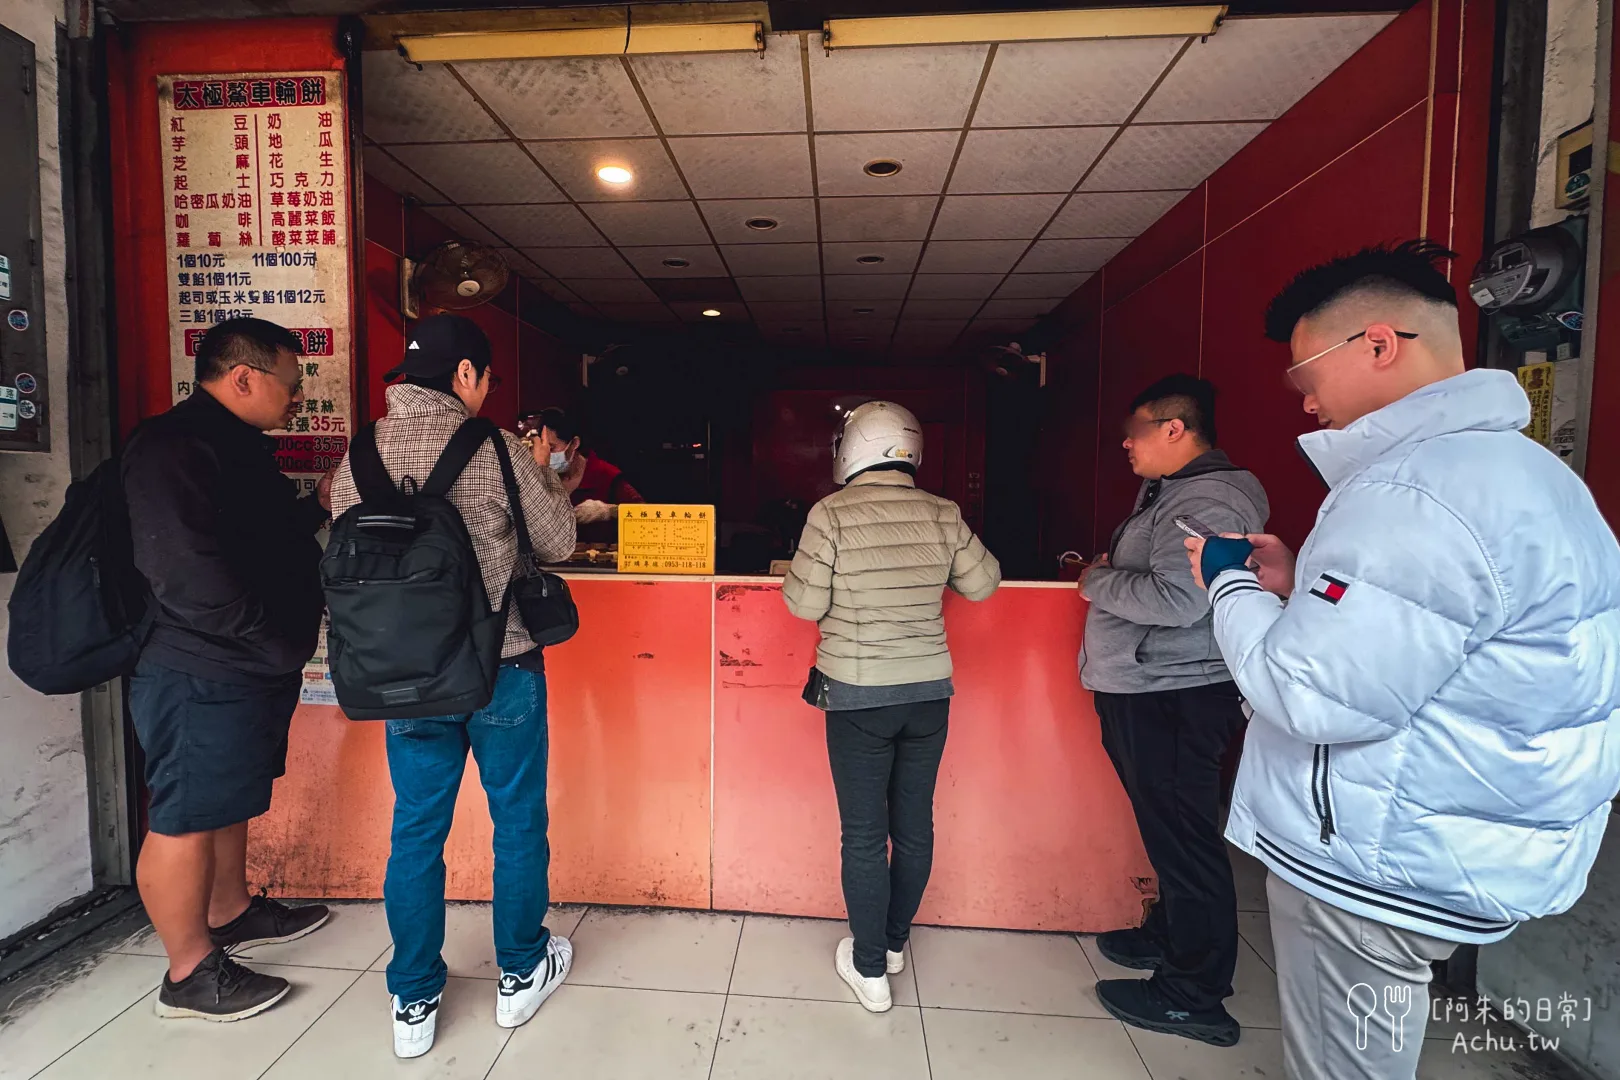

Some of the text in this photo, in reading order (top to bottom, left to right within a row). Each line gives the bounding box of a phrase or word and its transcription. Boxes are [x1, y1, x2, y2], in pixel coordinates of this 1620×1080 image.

[171, 115, 248, 133] 紅豆
[267, 111, 333, 129] 奶油
[172, 134, 249, 152] 芋頭
[268, 131, 333, 149] 地瓜
[173, 154, 250, 172] 芝麻
[269, 151, 334, 169] 花生
[174, 173, 250, 191] 起士
[270, 171, 334, 189] 巧克力
[175, 193, 252, 210] 哈密瓜奶油
[270, 190, 334, 208] 草莓奶油
[176, 211, 252, 229] 咖啡
[271, 209, 336, 227] 高麗菜飯
[177, 253, 226, 268] 1個10元
[252, 252, 316, 267] 11個100元
[178, 272, 252, 287] 雙餡1個11元
